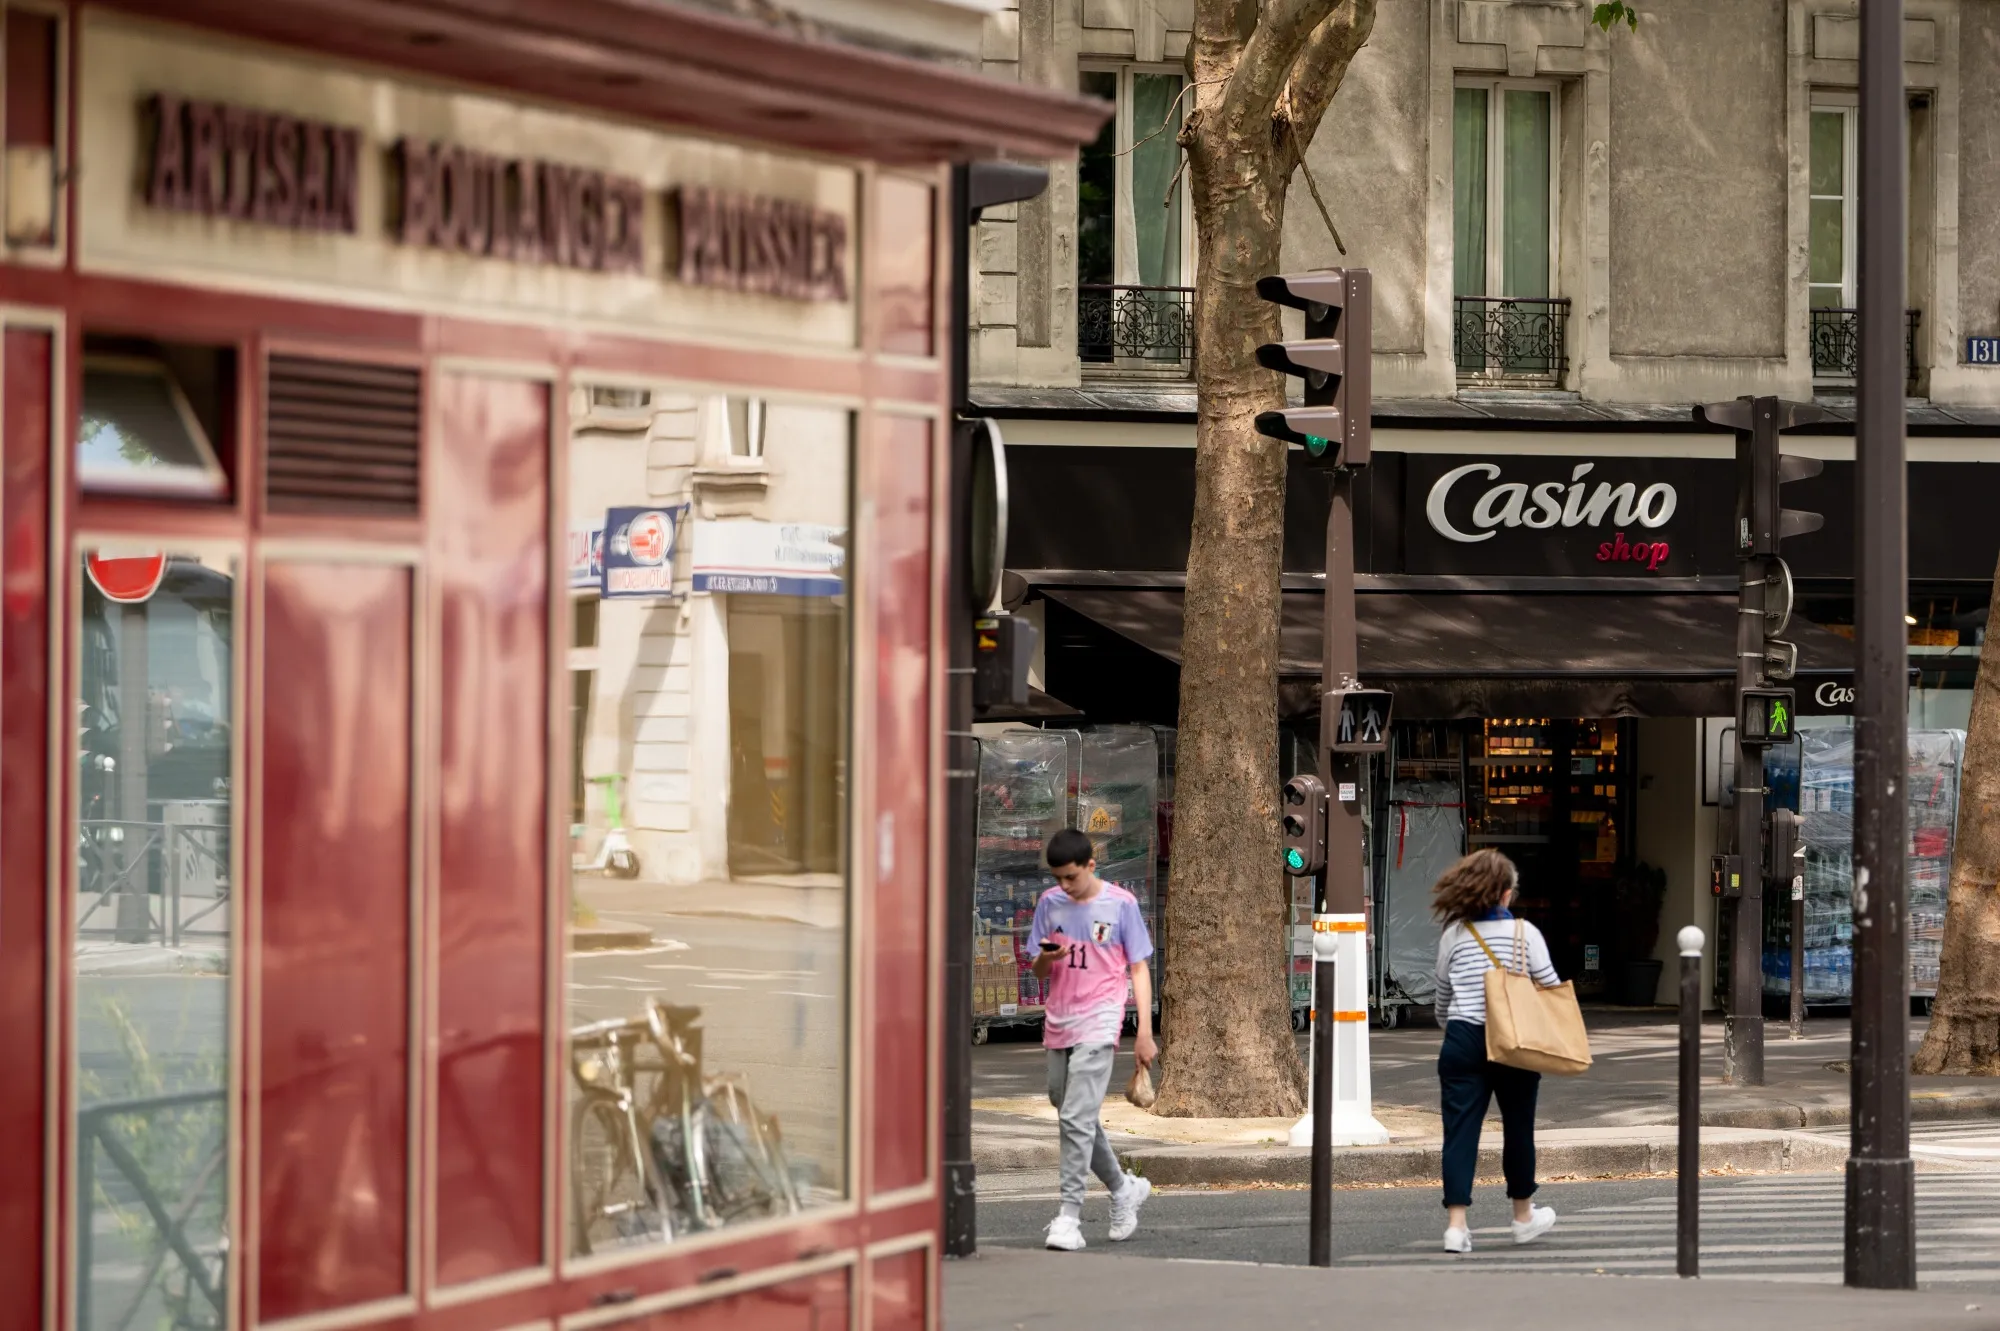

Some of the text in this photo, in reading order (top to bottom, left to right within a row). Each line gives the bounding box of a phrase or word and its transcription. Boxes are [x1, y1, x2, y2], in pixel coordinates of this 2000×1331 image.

[145, 92, 850, 301] ARTISAN BOULANGER PATISSIER
[1971, 339, 1998, 362] 131
[1425, 462, 1678, 543] Casino
[1595, 532, 1670, 571] shop
[1815, 681, 1856, 707] Cas
[1068, 943, 1088, 970] 11
